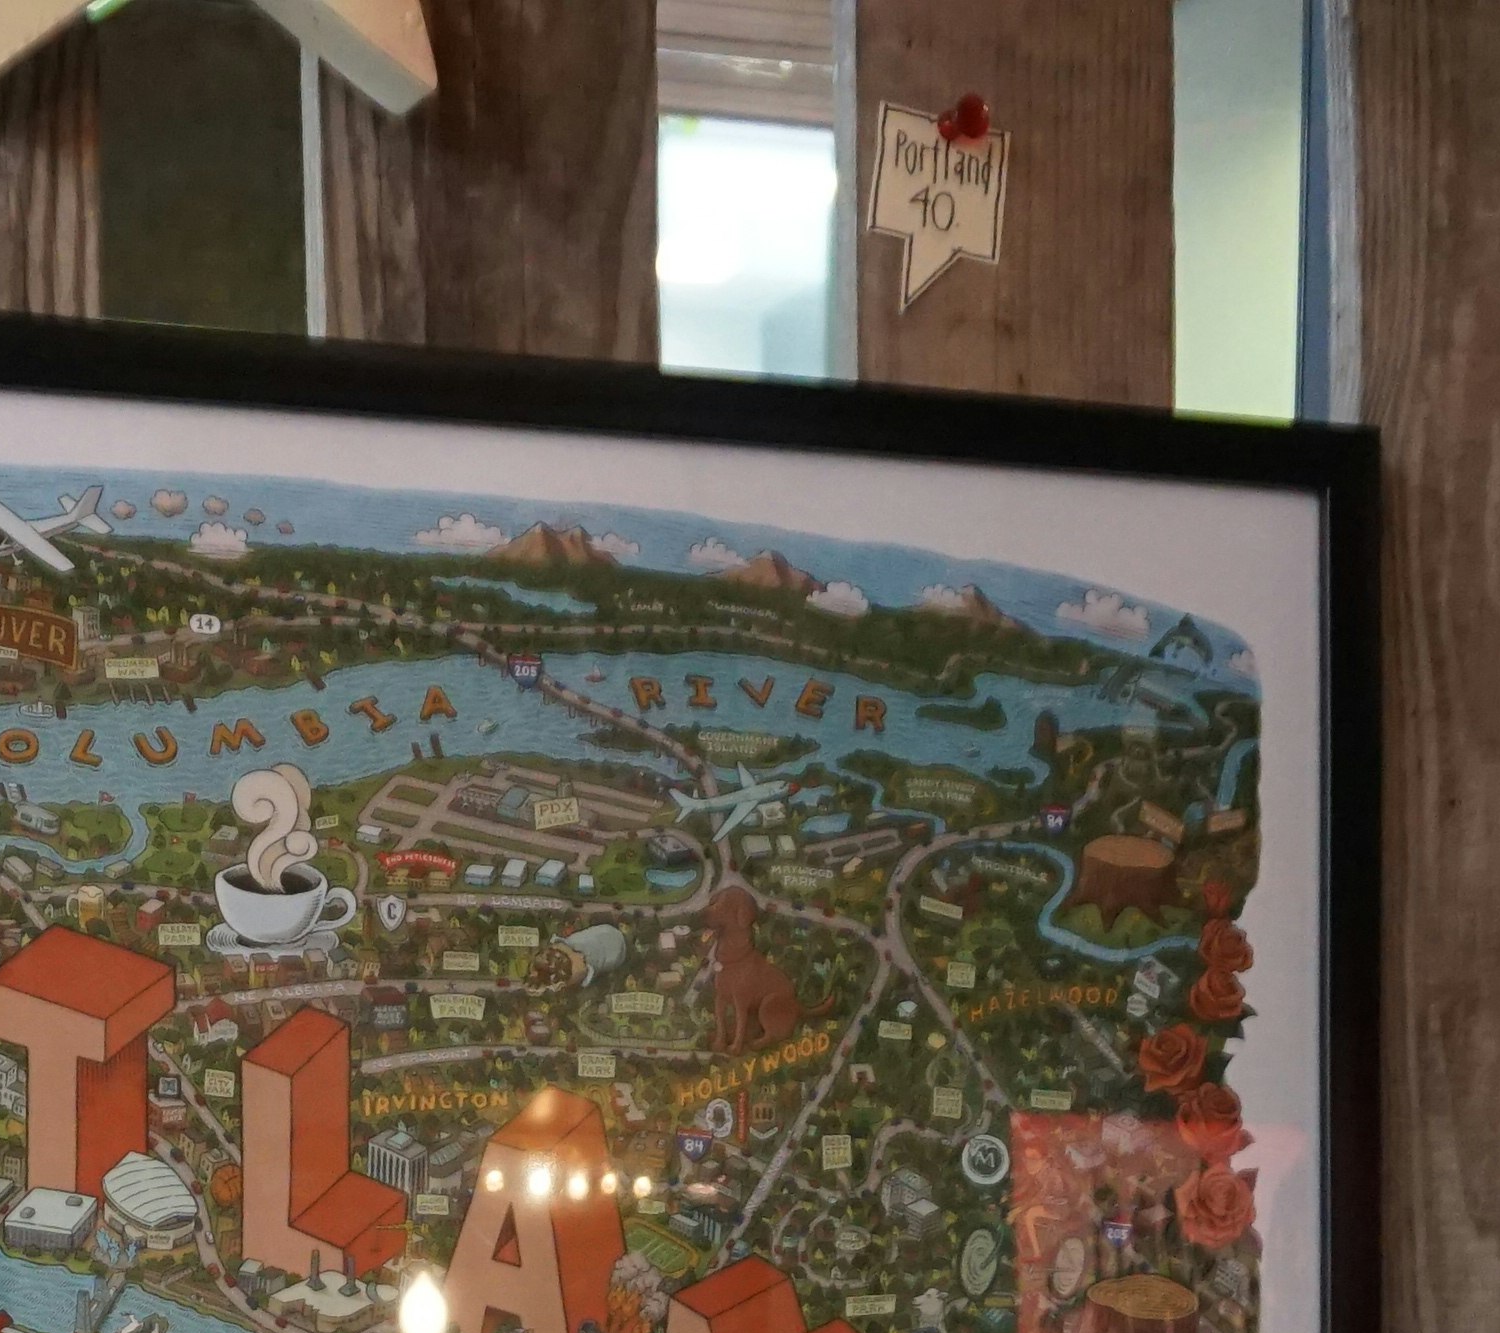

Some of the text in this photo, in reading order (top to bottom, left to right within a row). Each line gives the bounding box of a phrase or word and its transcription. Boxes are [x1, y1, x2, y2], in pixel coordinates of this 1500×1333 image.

[895, 128, 994, 194] Portland
[628, 675, 888, 732] RIVER
[968, 986, 1119, 1022] HAZELWOOD
[677, 1031, 832, 1104] HOLLYWOOD
